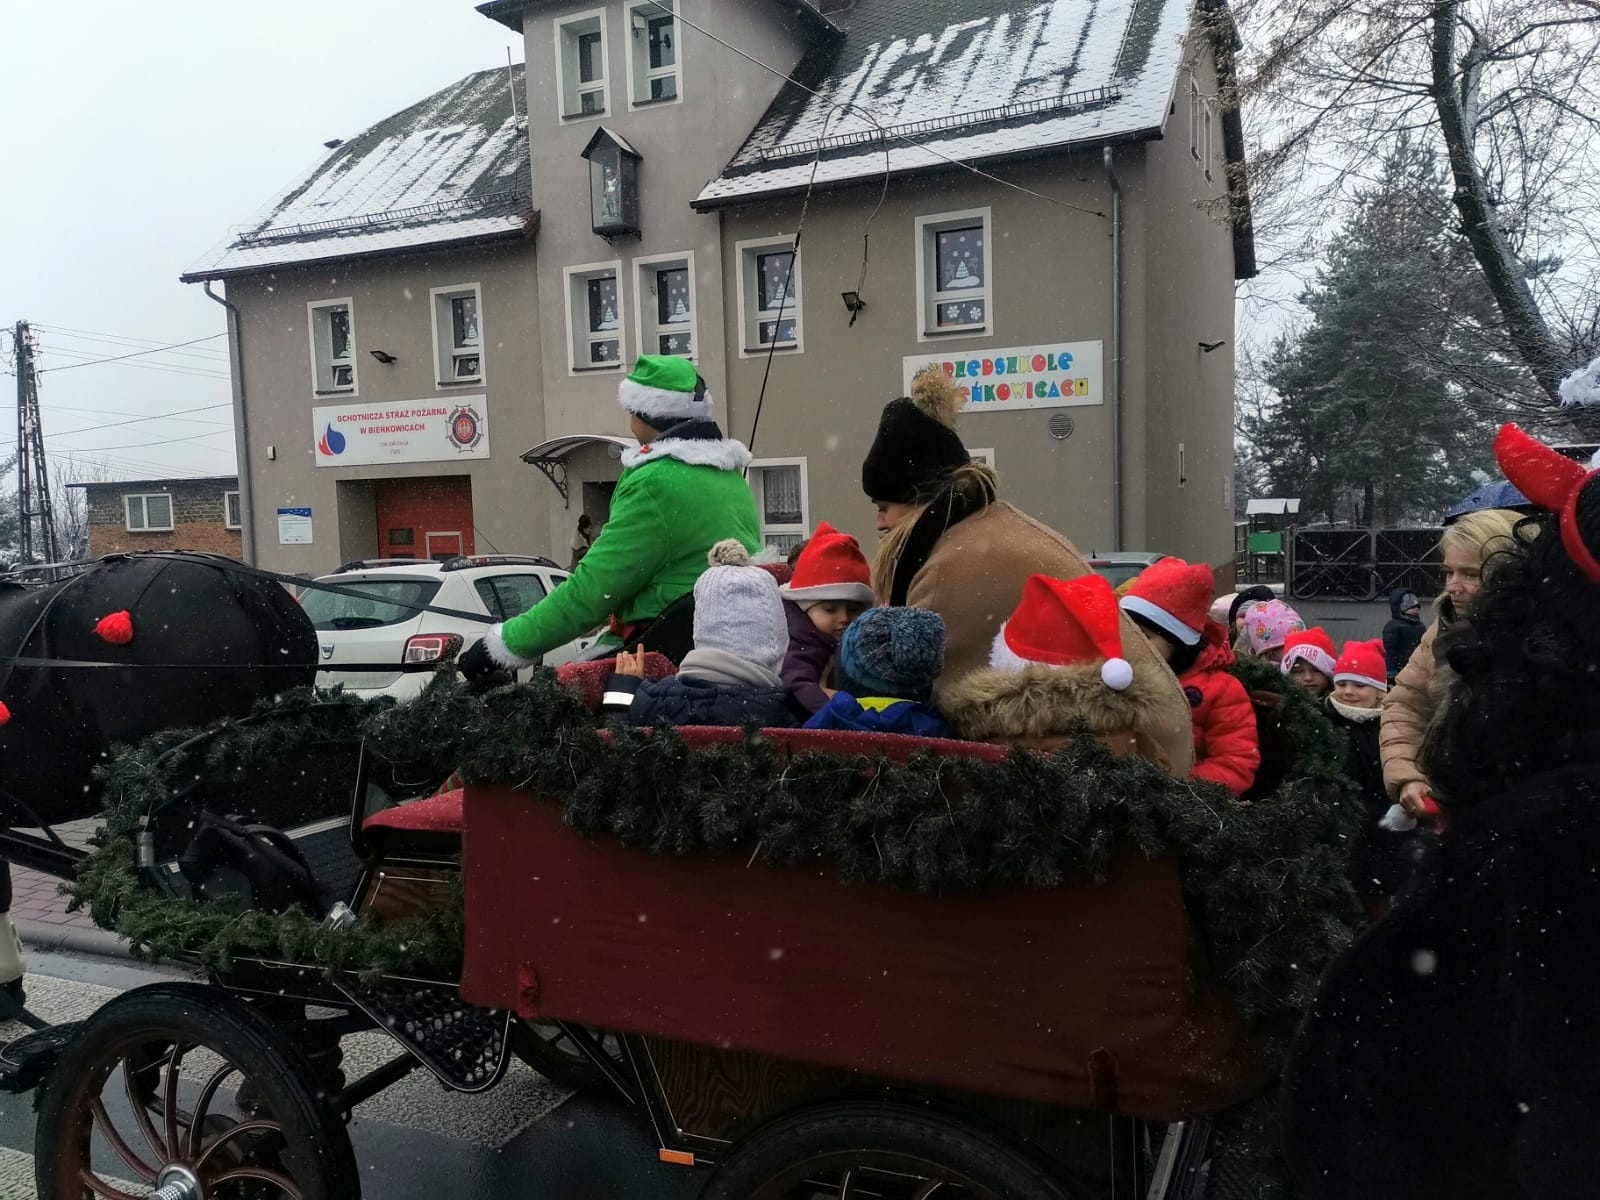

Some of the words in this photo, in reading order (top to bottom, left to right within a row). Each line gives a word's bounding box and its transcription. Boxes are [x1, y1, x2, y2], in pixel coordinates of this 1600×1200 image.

[958, 378, 1088, 403] EŃKOWICACH
[337, 412, 384, 423] OCHOTNICZA
[385, 409, 410, 419] STRAŻ
[411, 407, 447, 417] POŻARNA
[360, 427, 367, 435] W
[1300, 646, 1319, 662] STAR
